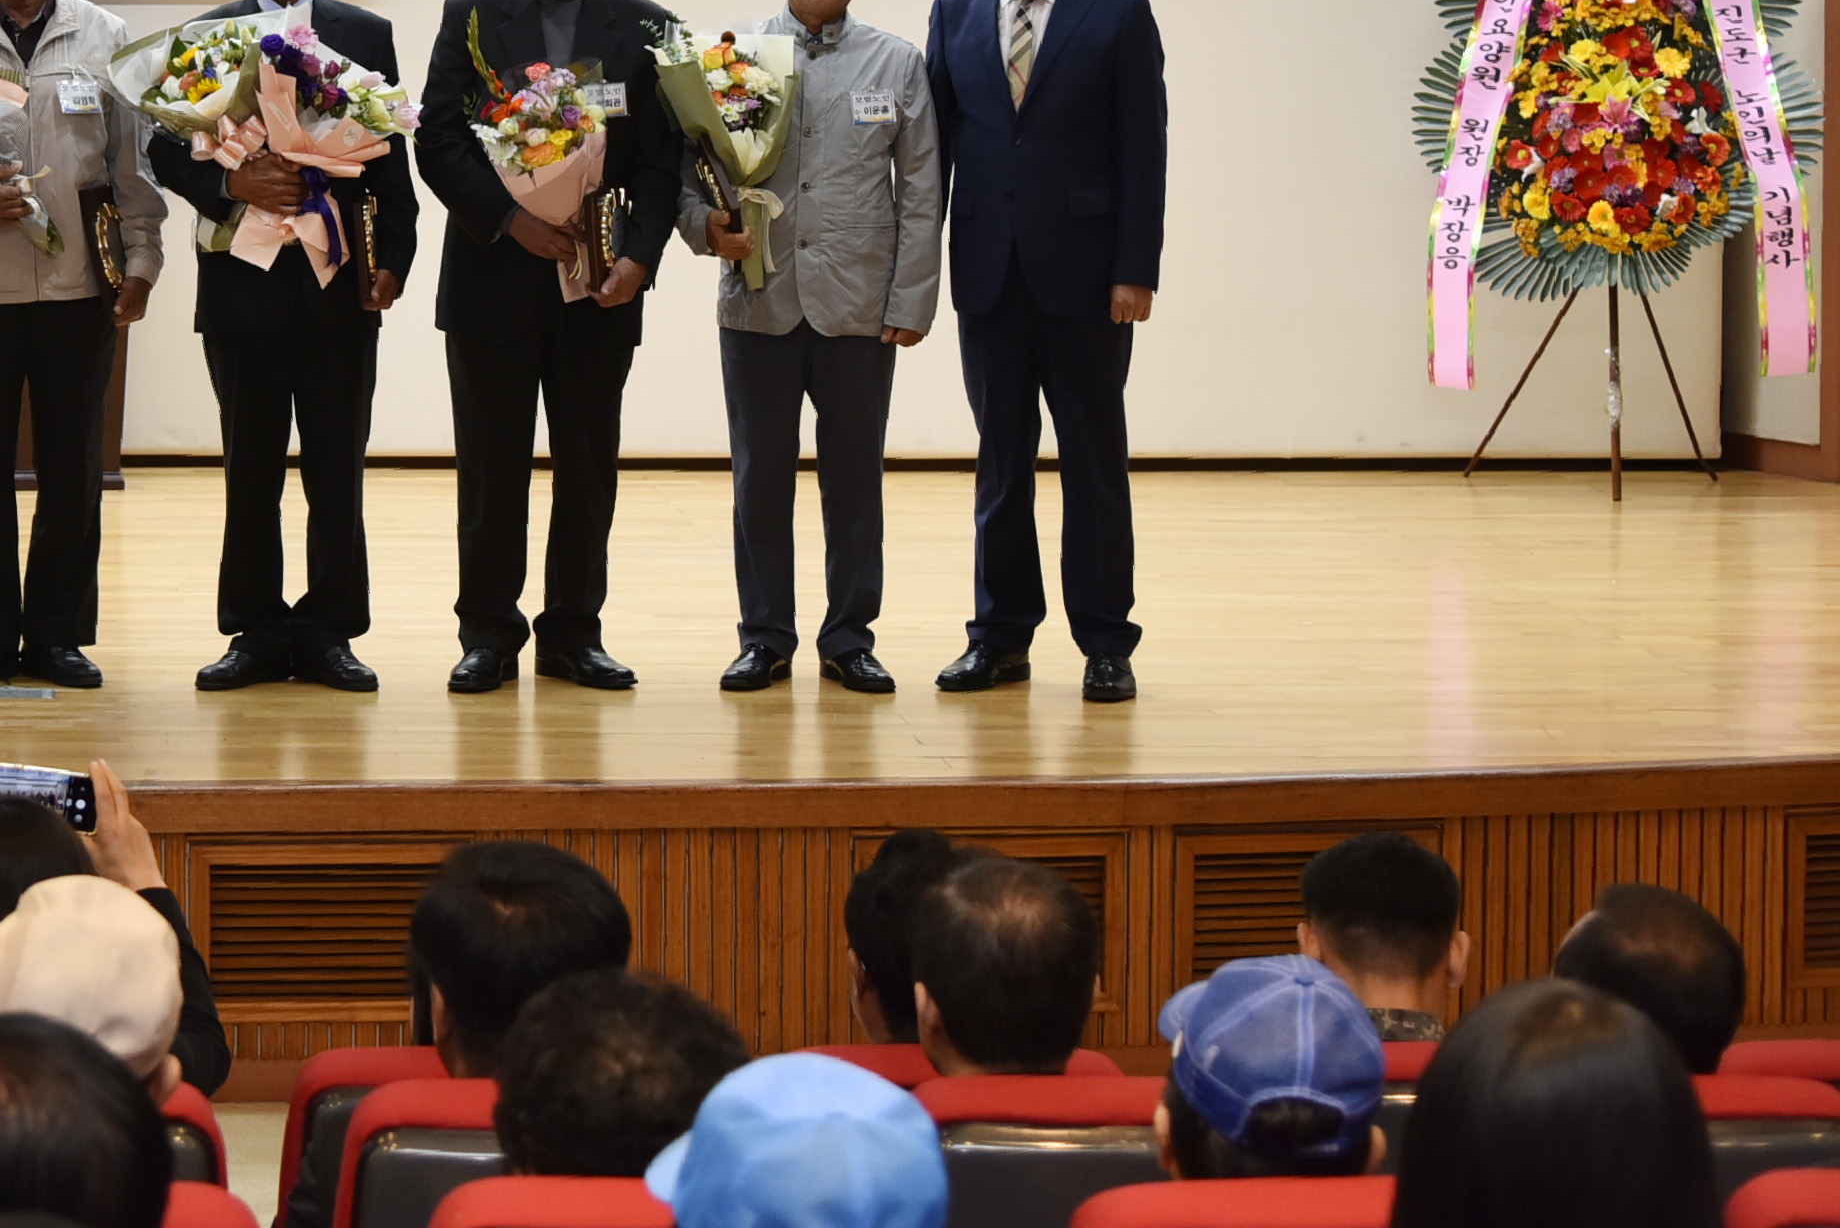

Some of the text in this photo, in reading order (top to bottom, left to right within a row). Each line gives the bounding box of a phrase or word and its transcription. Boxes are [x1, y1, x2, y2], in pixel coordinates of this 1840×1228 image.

[1457, 118, 1489, 167] 원장
[1714, 4, 1757, 65] 진도군
[1764, 185, 1801, 269] 기념행사
